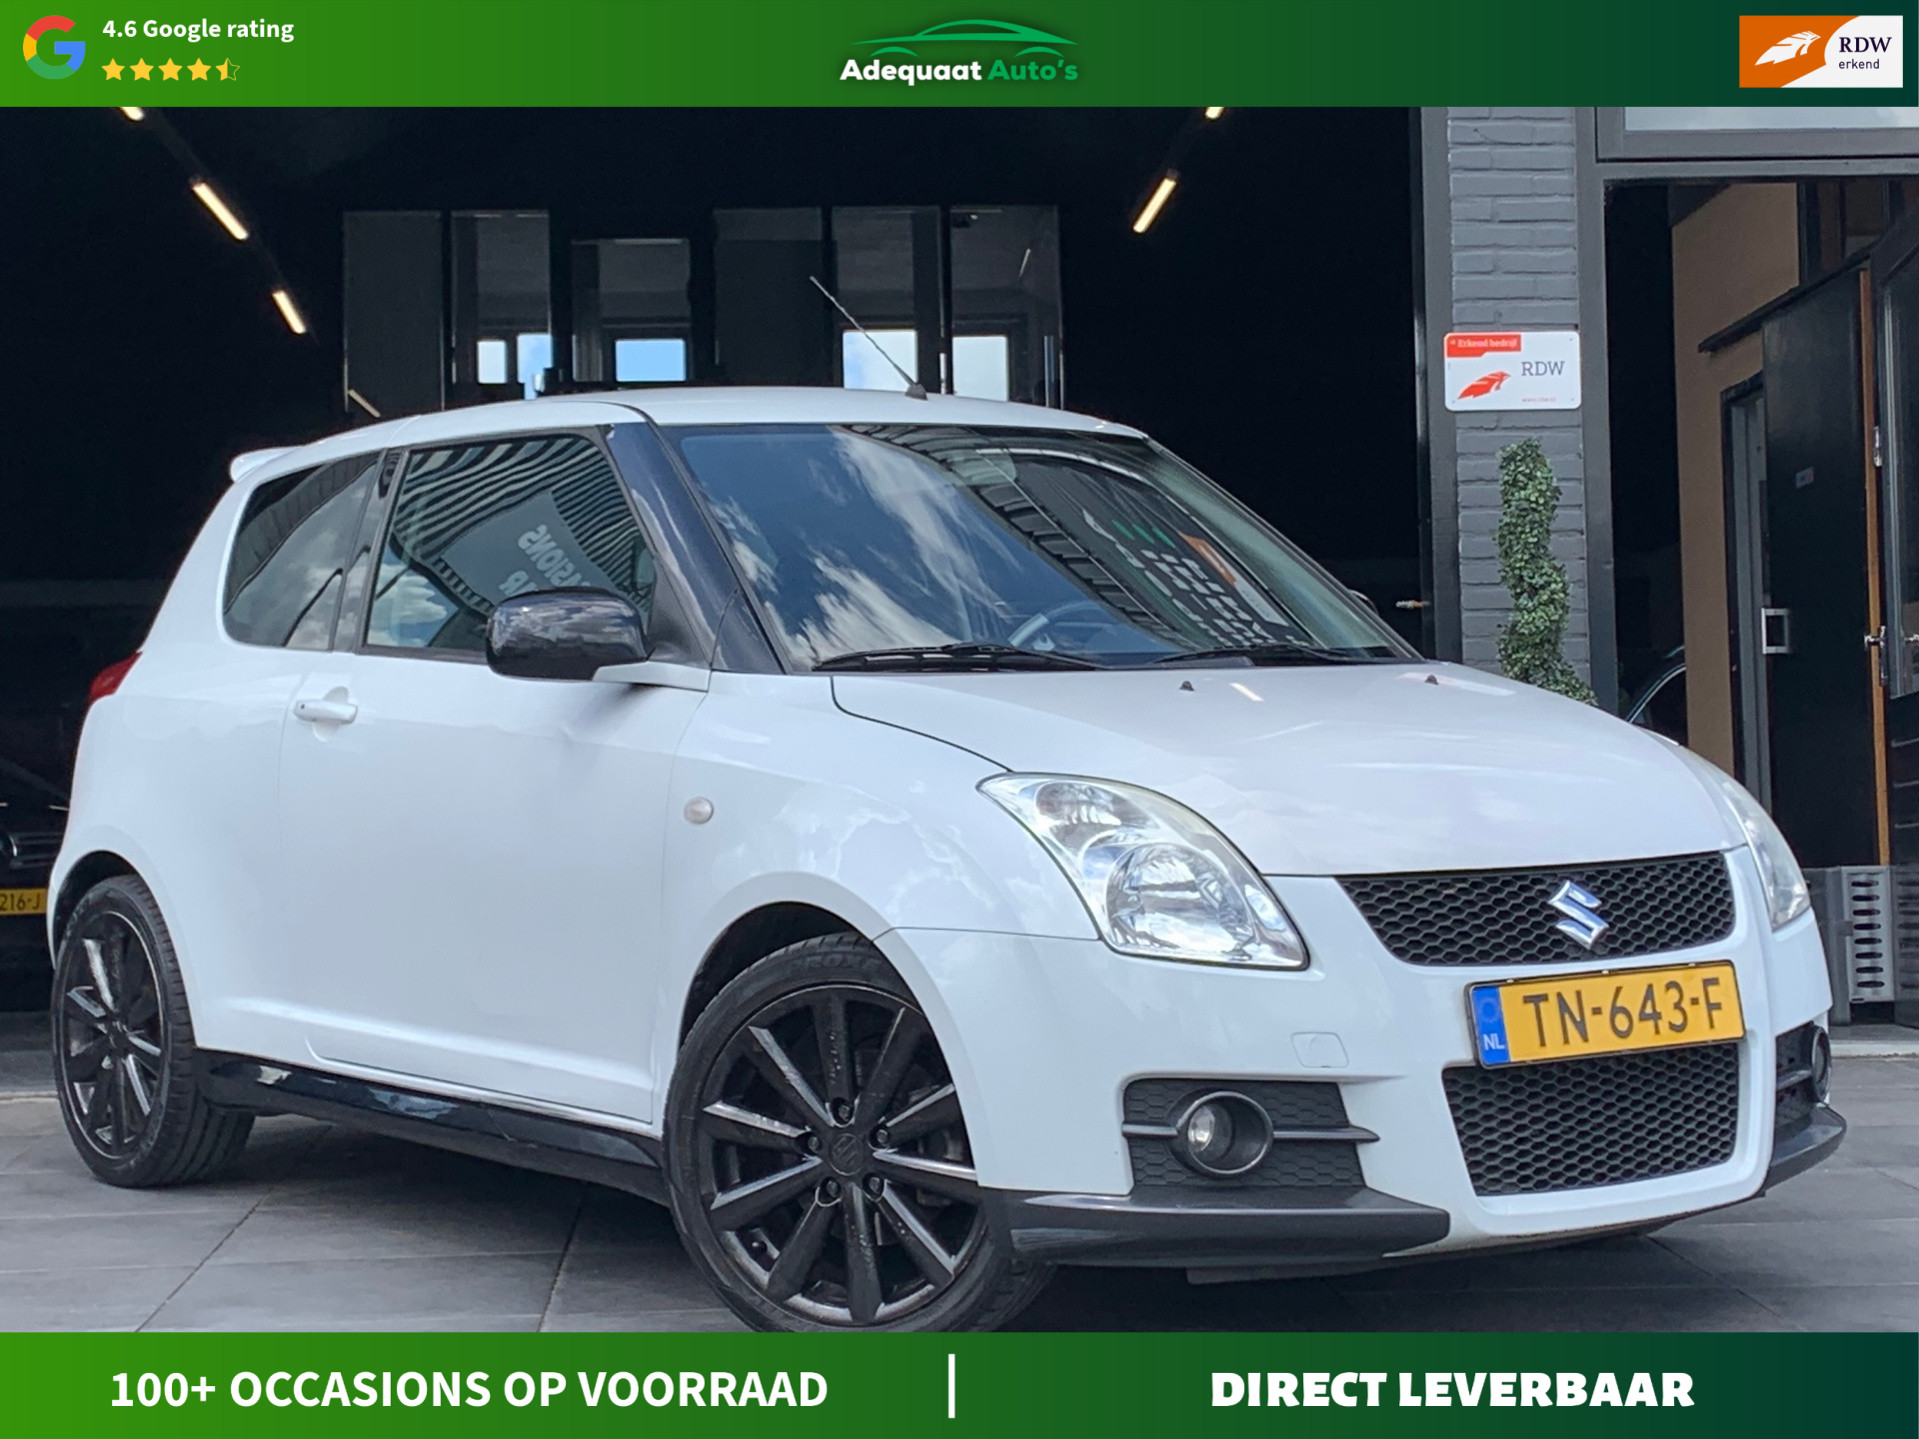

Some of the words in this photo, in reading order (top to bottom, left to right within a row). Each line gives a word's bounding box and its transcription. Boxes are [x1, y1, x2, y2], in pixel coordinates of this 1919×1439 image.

[1521, 360, 1565, 377] RDW
[1482, 1032, 1506, 1051] NL
[1522, 976, 1722, 1048] TN-643-F
